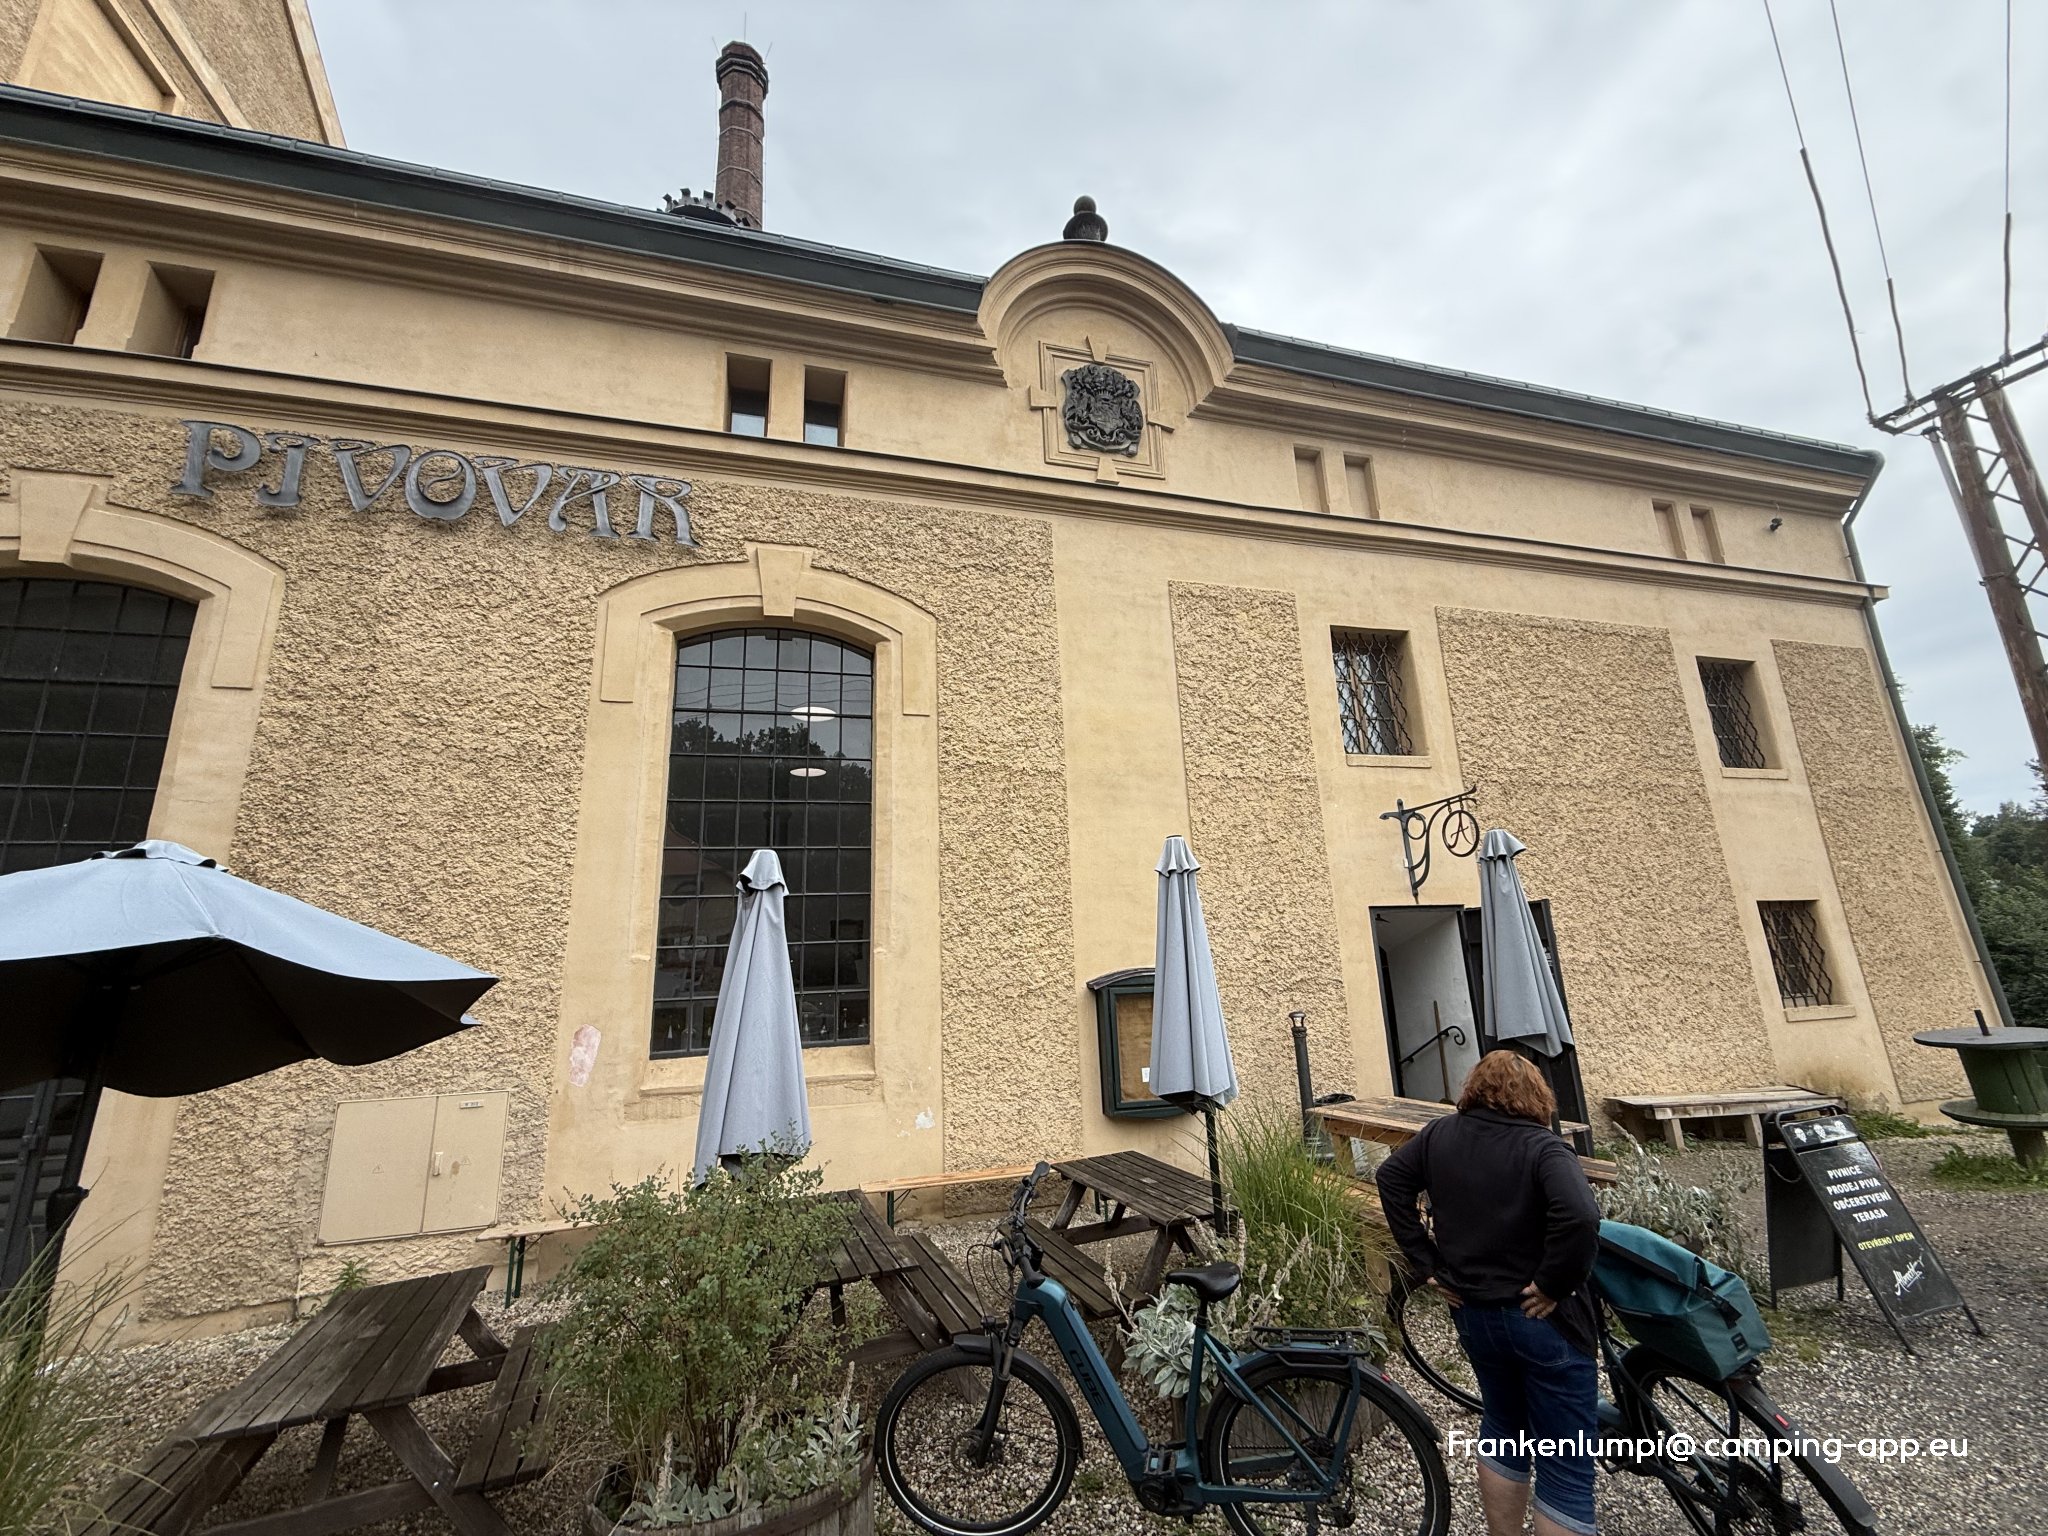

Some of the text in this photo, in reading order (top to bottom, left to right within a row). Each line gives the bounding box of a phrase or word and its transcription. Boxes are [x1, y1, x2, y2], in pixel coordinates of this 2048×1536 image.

[1827, 1165, 1863, 1179] PIVNICE
[1826, 1178, 1881, 1195] PRODEJ PIVA
[1833, 1189, 1891, 1210] OBČERSTVENÍ
[1852, 1208, 1888, 1222] TERASA
[1858, 1237, 1892, 1250] OTEVŘENO
[1895, 1232, 1915, 1242] OPEN
[1069, 1350, 1106, 1406] CUBE
